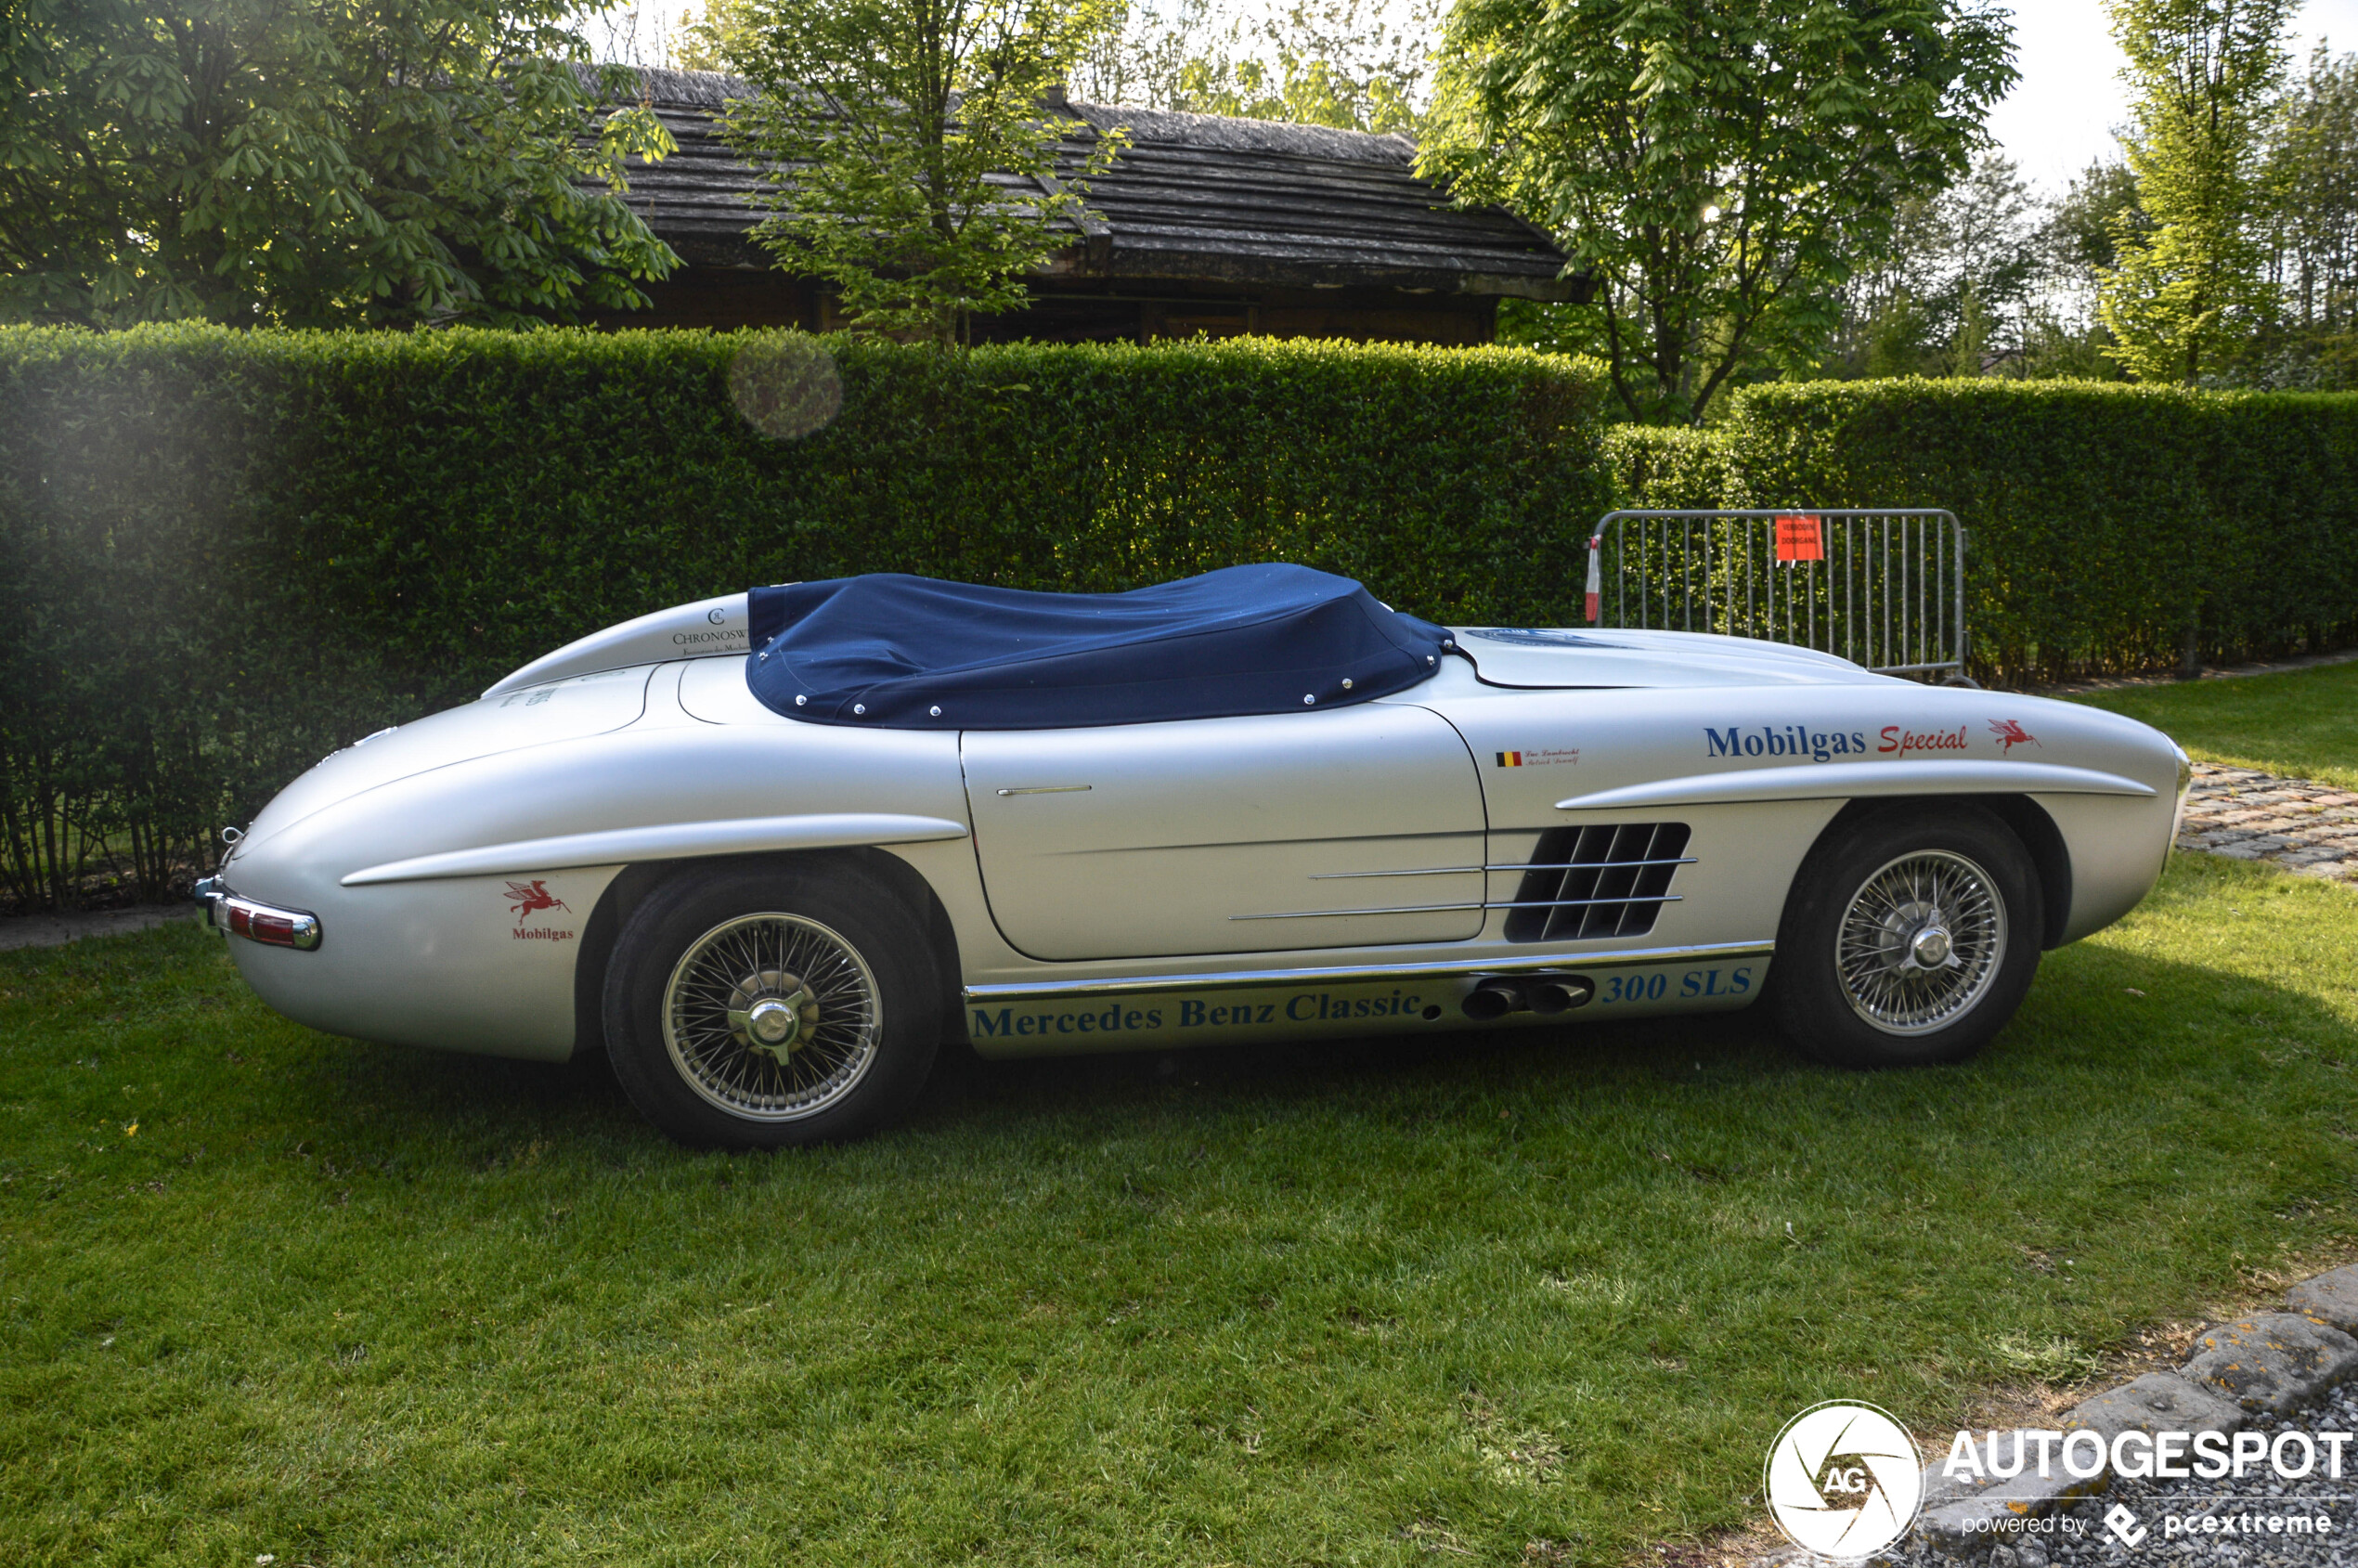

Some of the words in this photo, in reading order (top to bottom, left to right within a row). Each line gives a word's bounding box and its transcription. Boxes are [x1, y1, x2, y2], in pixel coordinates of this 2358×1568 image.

[672, 629, 749, 645] CHRONOSW
[1704, 725, 1866, 762] Mobilgas
[1878, 725, 1967, 758] Special
[512, 927, 574, 941] Mobilgas
[1602, 973, 1667, 1004] 300
[1679, 967, 1753, 998] SLS
[972, 1004, 1163, 1038] Mercedes
[1178, 1000, 1275, 1028] Benz
[1285, 990, 1421, 1022] Classic
